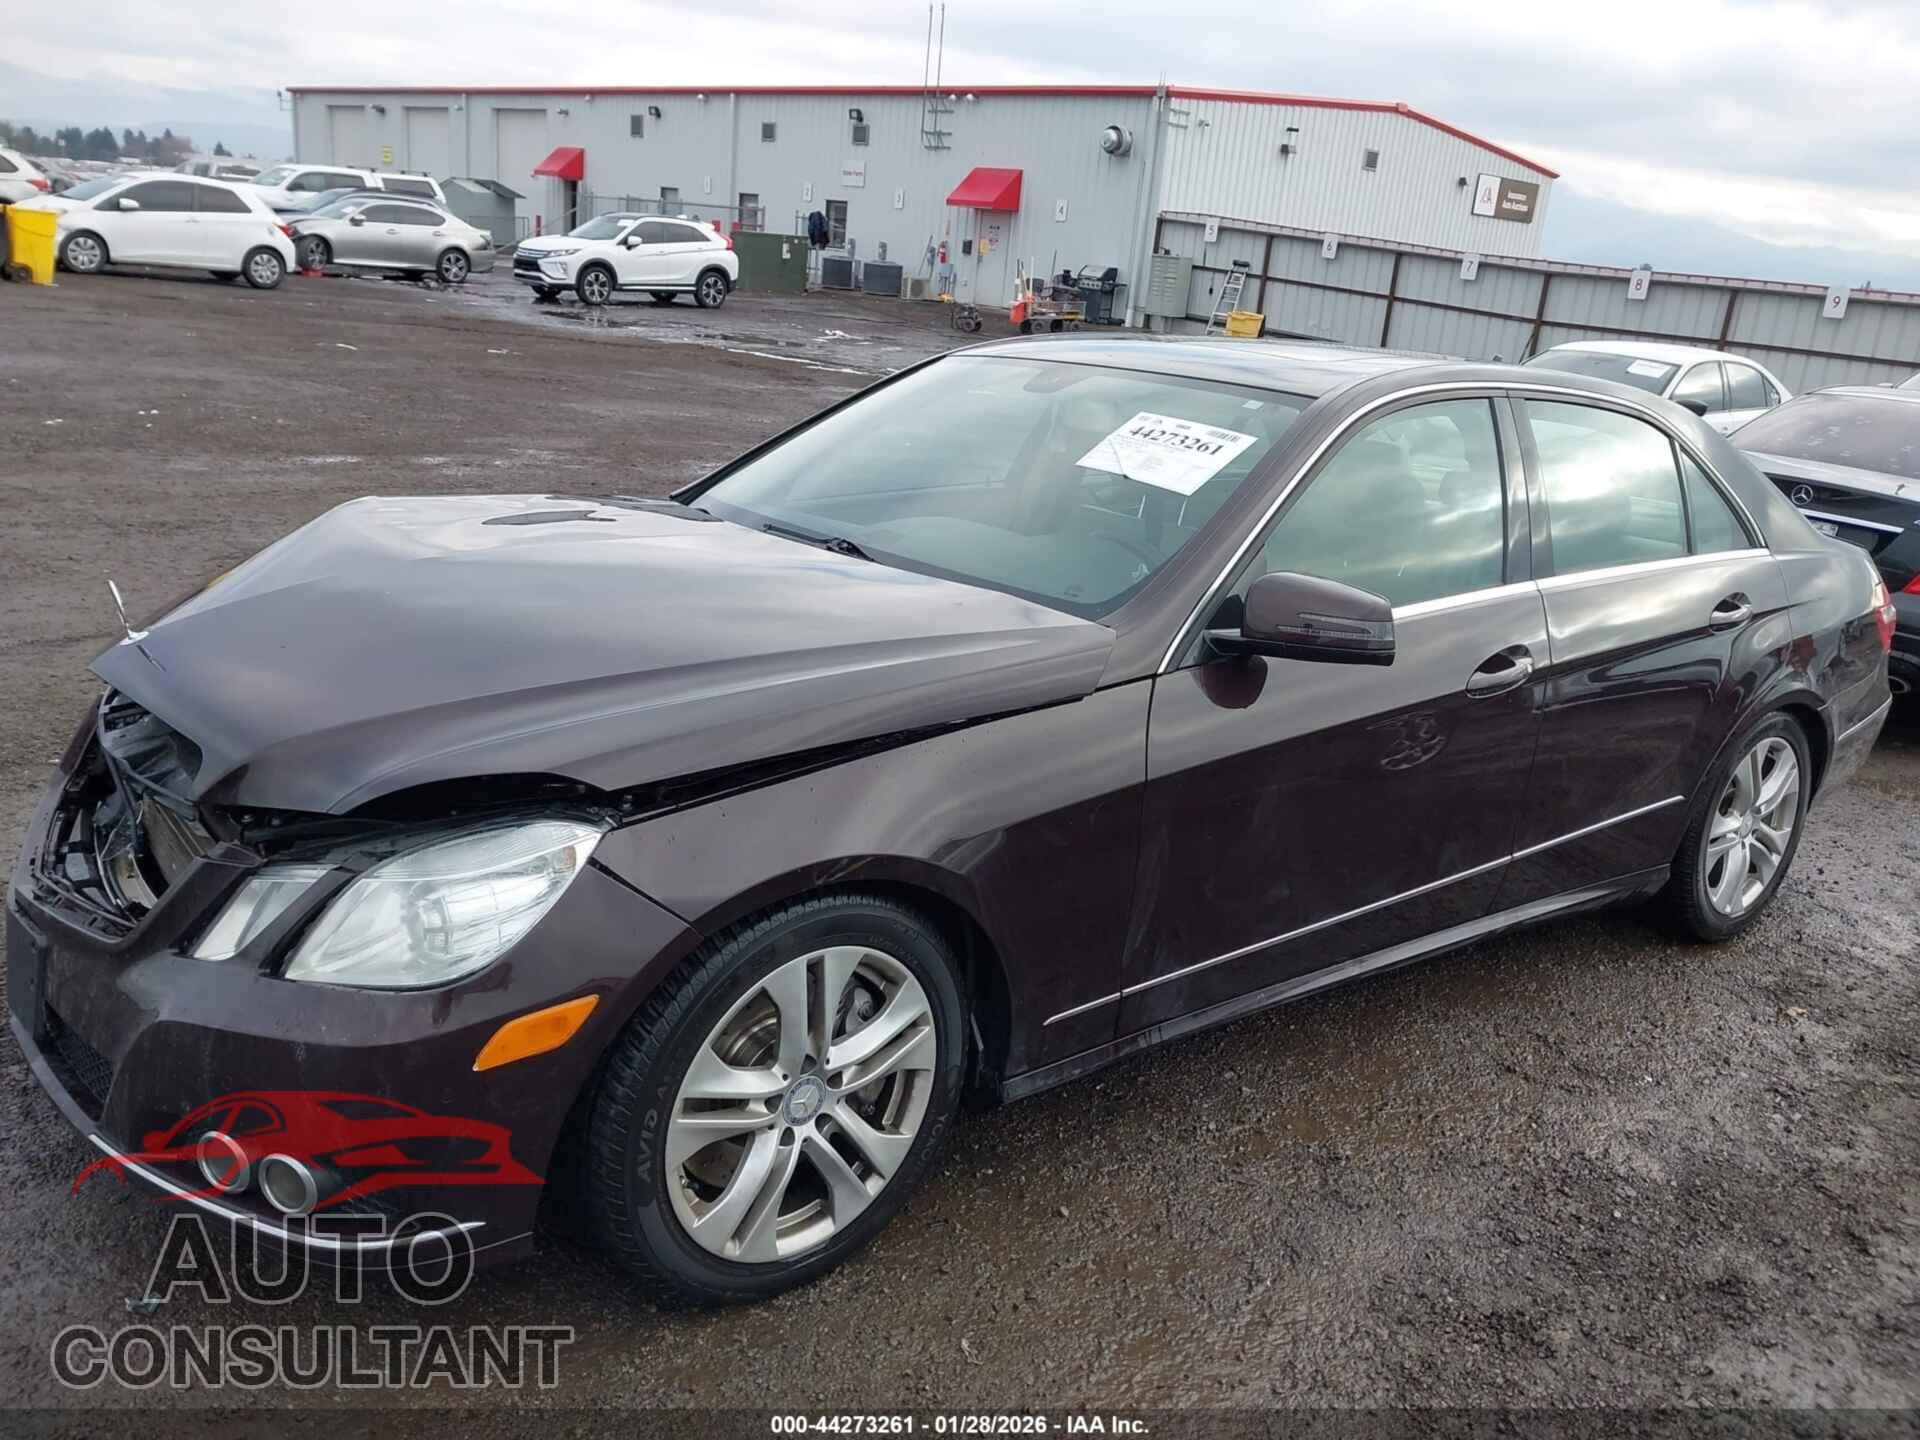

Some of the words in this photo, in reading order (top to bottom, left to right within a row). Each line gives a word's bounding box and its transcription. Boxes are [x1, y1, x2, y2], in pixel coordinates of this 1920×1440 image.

[1207, 224, 1215, 236] 5
[1326, 240, 1333, 252] 6
[1466, 260, 1474, 272] 7
[1634, 278, 1643, 291] 8
[1831, 295, 1841, 309] 9
[1129, 426, 1225, 455] 44273261
[637, 1108, 658, 1183] AVID
